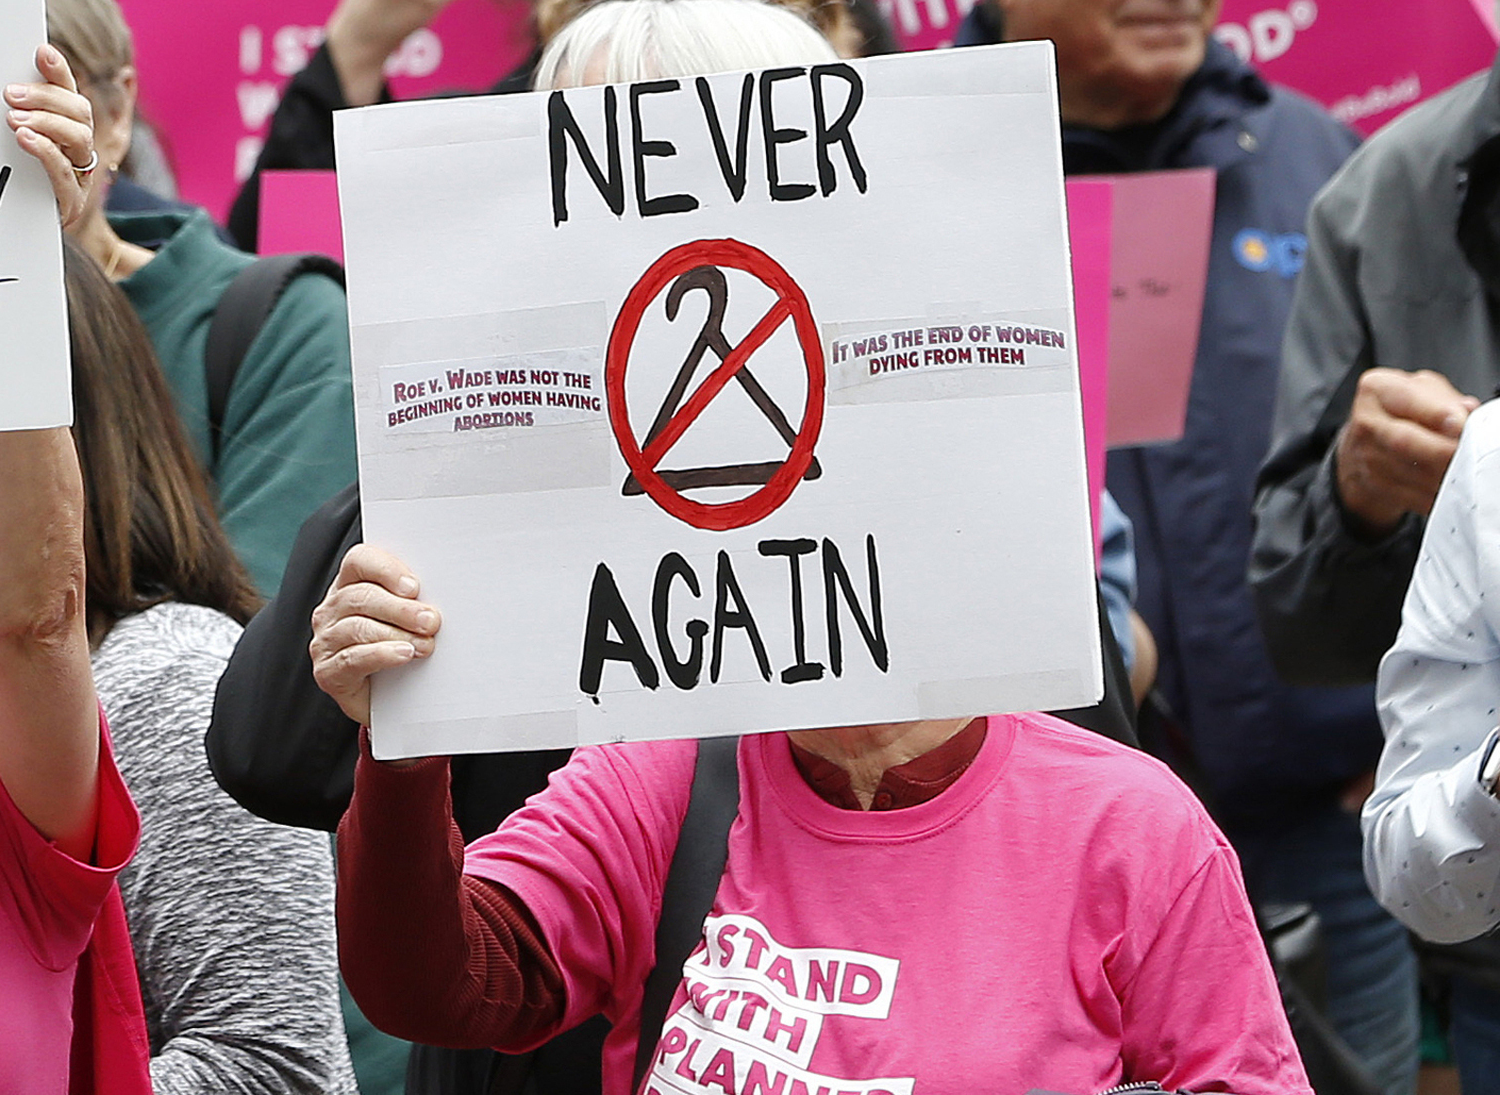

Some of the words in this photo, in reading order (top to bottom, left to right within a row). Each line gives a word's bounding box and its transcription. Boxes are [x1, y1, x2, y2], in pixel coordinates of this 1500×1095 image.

[549, 63, 868, 228] NEVER
[579, 533, 890, 701] AGAIN
[717, 923, 883, 1005] STAND
